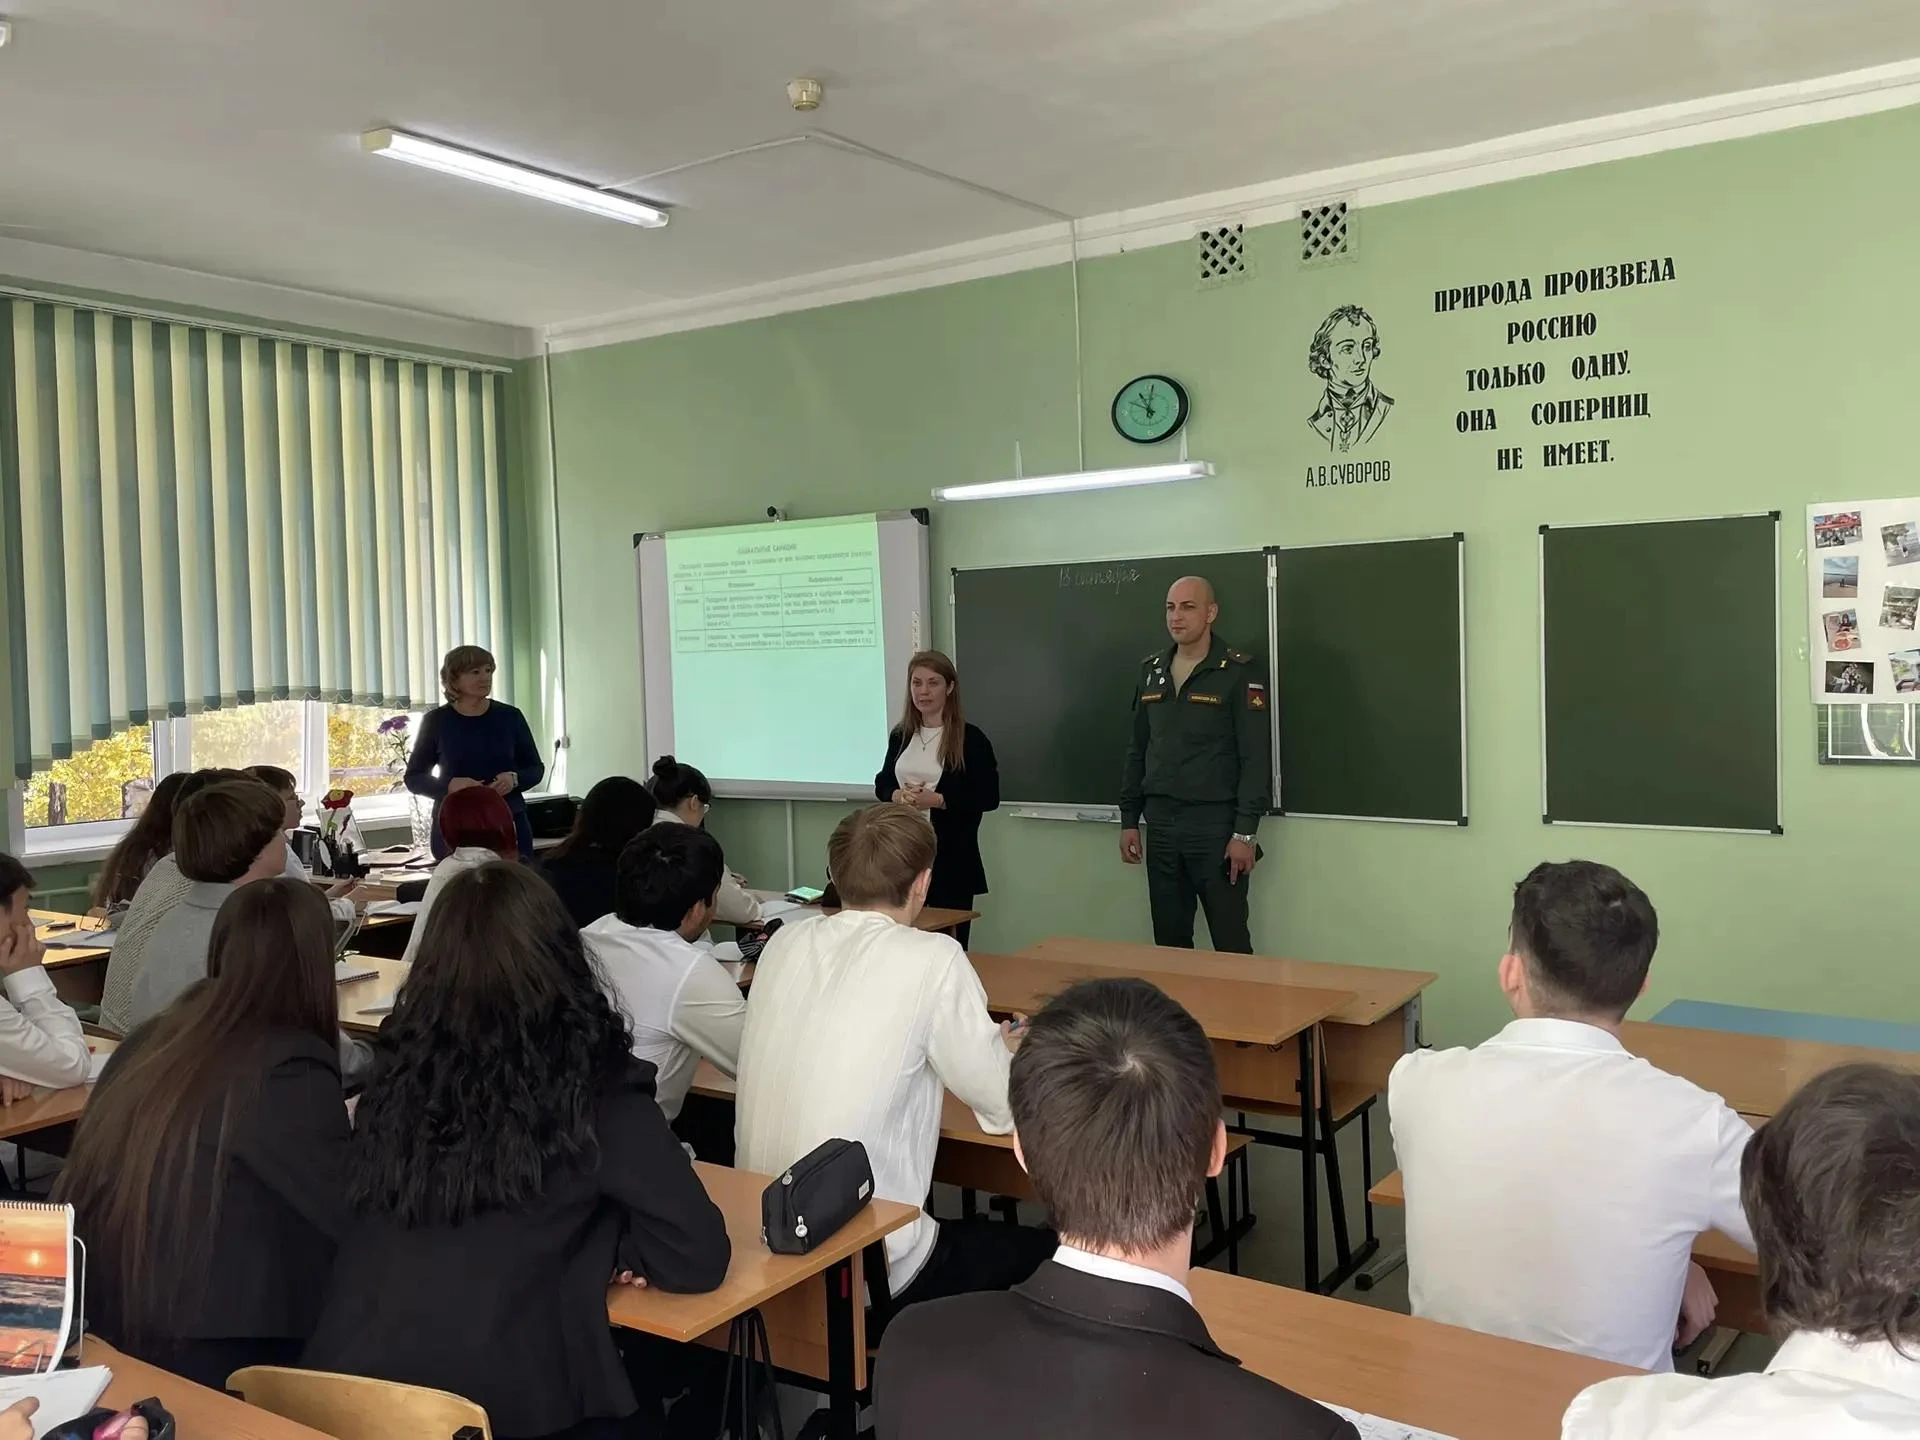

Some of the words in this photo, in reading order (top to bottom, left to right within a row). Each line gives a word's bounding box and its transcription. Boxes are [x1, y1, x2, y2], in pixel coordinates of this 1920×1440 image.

[1435, 278, 1532, 313] ПРИРОДА
[1545, 257, 1676, 298] ПРОИЗВЕЛА
[1507, 312, 1597, 345] РОССИЮ
[1466, 361, 1546, 392] ТОЛЬКО
[1571, 350, 1631, 381] ОДНУ.
[1456, 408, 1497, 433] ОНА
[1531, 392, 1651, 426] СОПЕРНИЦ
[1497, 447, 1523, 471] НЕ
[1544, 439, 1615, 467] ИМЕЕТ.
